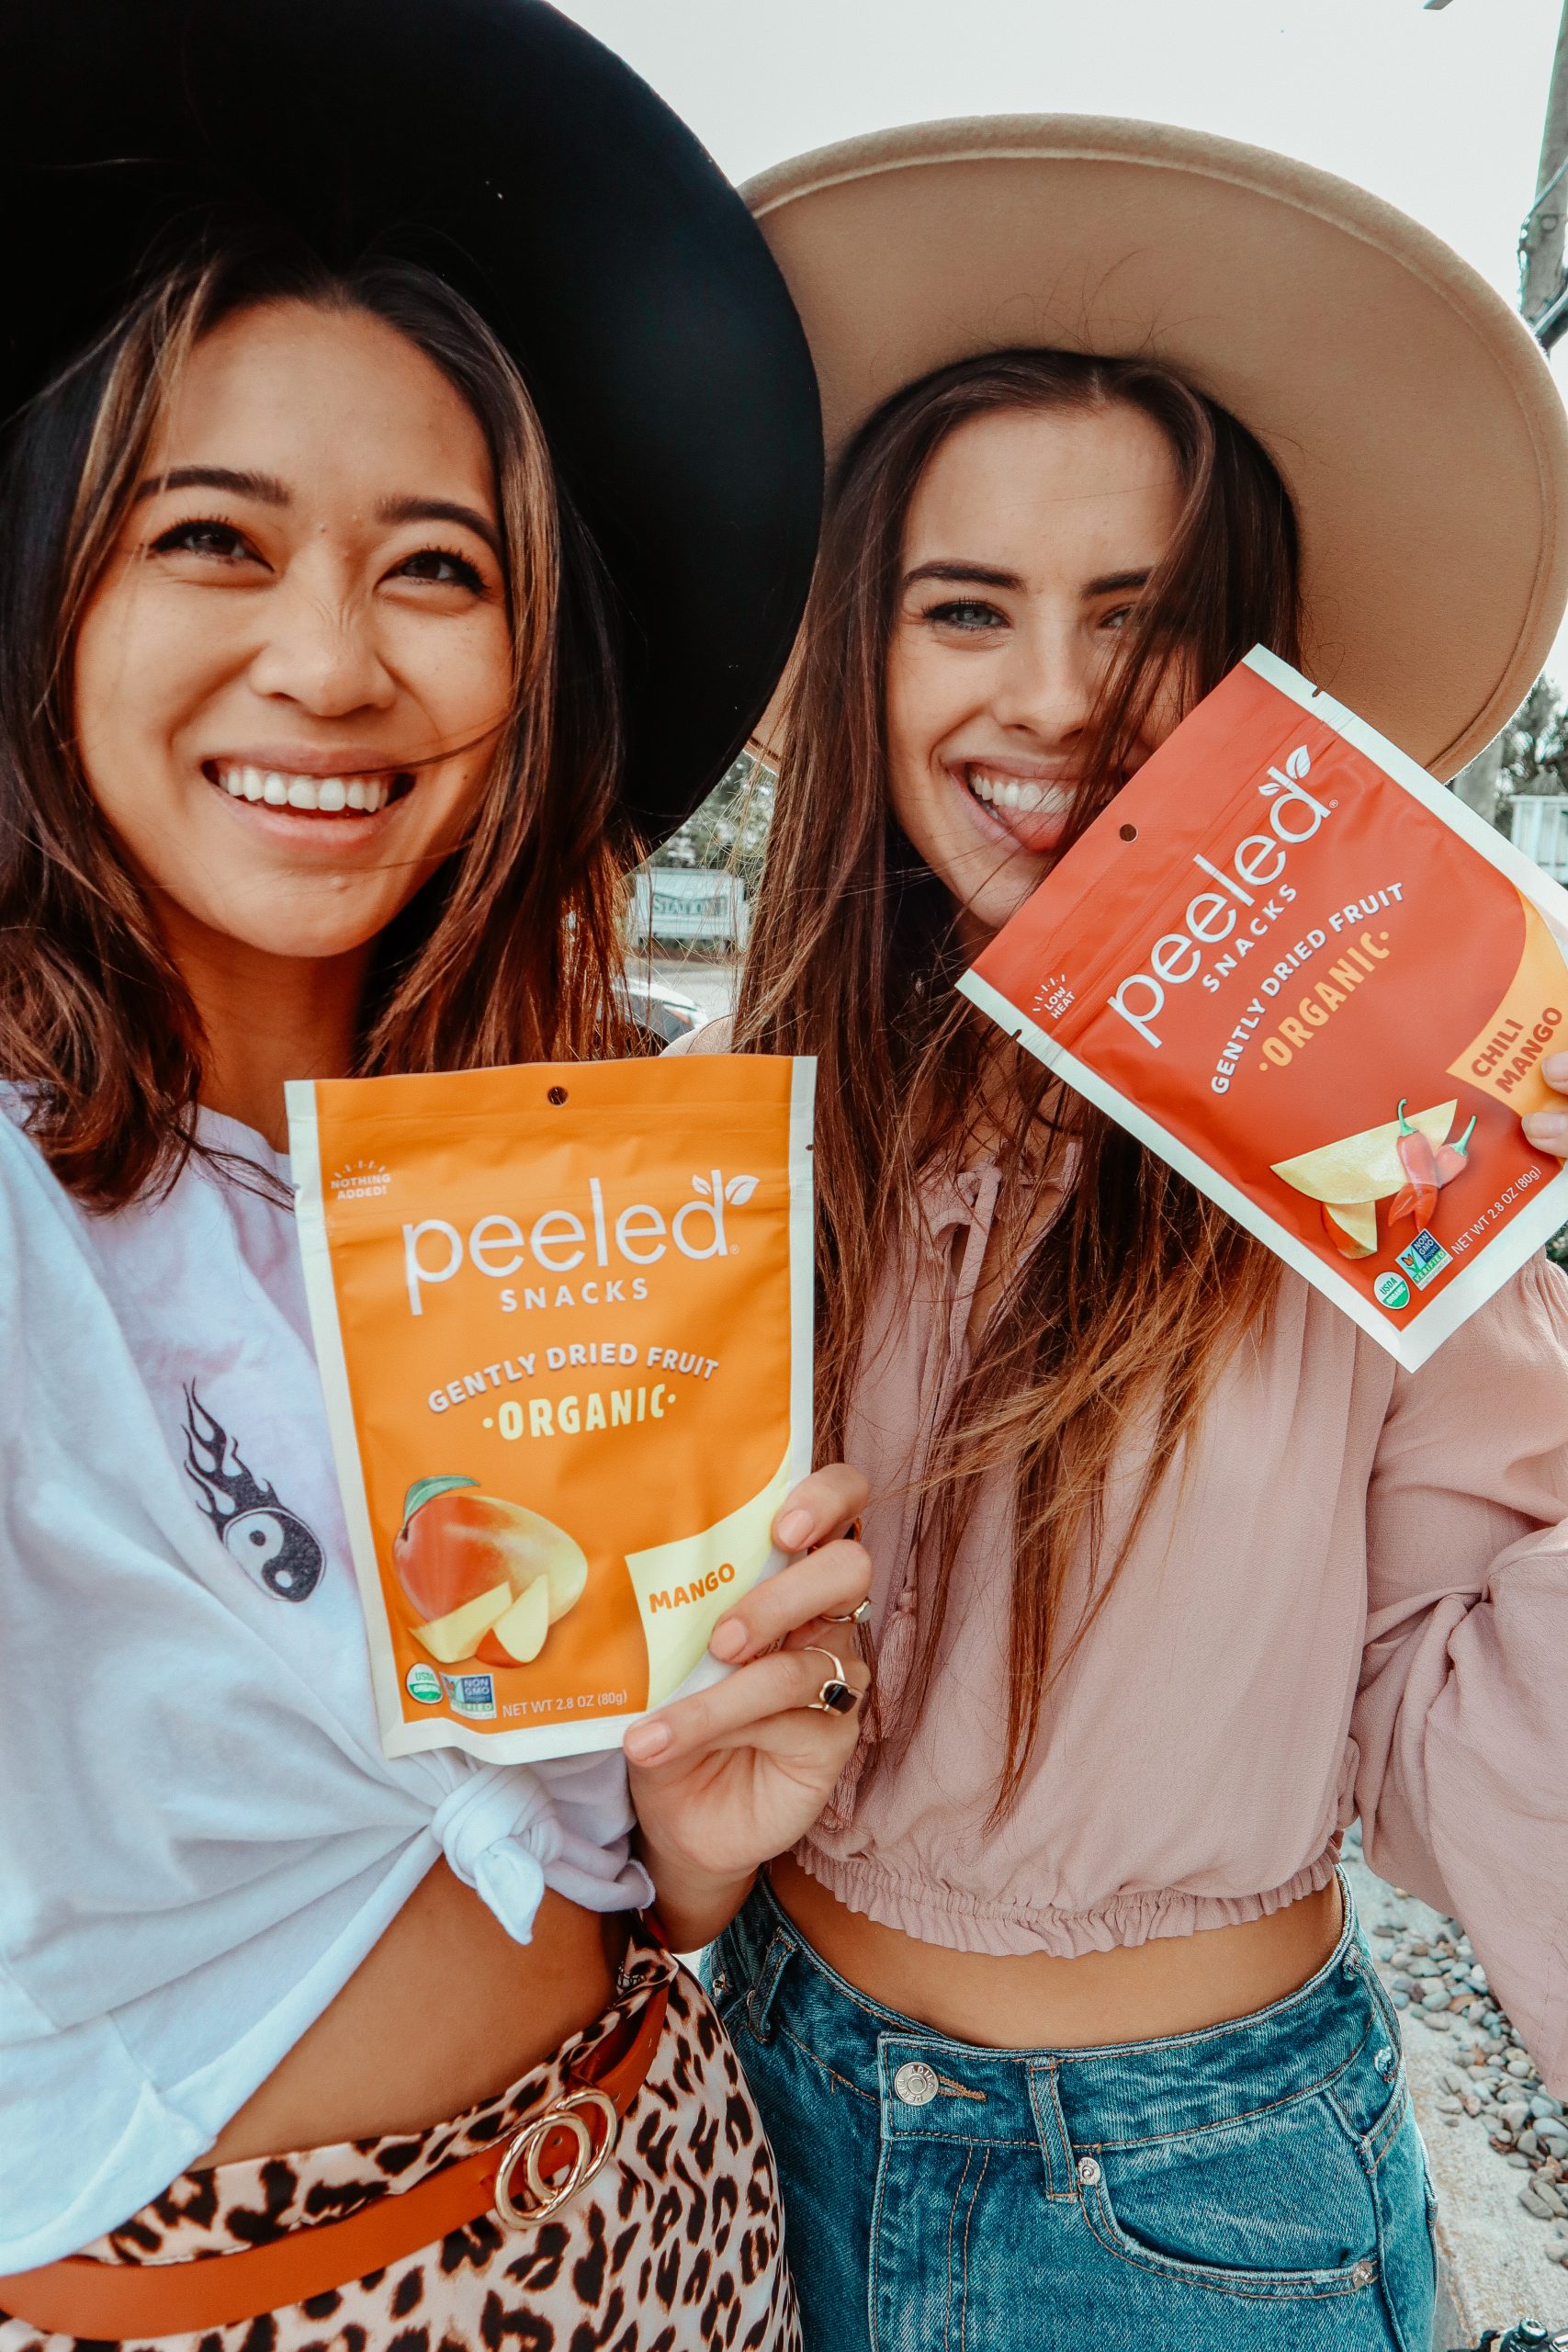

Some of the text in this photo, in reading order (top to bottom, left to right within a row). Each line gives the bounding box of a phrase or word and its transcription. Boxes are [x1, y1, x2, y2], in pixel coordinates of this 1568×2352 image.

[1106, 765, 1332, 1048] peeled
[1201, 883, 1297, 993] SNACKS
[1043, 986, 1066, 1011] LOW
[1211, 882, 1405, 1095] GENTLY DRIED FRUIT
[1050, 991, 1076, 1020] HEAT
[1471, 1018, 1524, 1079] CHILI
[1495, 1006, 1562, 1094] MANGO
[331, 1173, 392, 1190] NOTHING
[337, 1185, 388, 1201] ADDED!
[1451, 1165, 1542, 1255] NET WT 2.8 OZ (80g)
[402, 1169, 728, 1317] peeled
[1414, 1232, 1429, 1250] NON
[1418, 1238, 1434, 1255] GMO
[1414, 1251, 1446, 1283] VERIFIED
[500, 1277, 649, 1314] SNACKS
[1379, 1277, 1397, 1295] USDA
[1386, 1284, 1406, 1305] ORGANIC
[427, 1342, 720, 1413] GENTLY DRIED FRUIT
[649, 1563, 736, 1614] MANGO
[463, 1679, 490, 1688] NON
[464, 1687, 491, 1696] GMO
[502, 1702, 527, 1717] NET
[531, 1700, 552, 1713] WT
[556, 1698, 574, 1711] 2.8
[577, 1694, 594, 1708] OZ
[597, 1690, 628, 1706] (80g)
